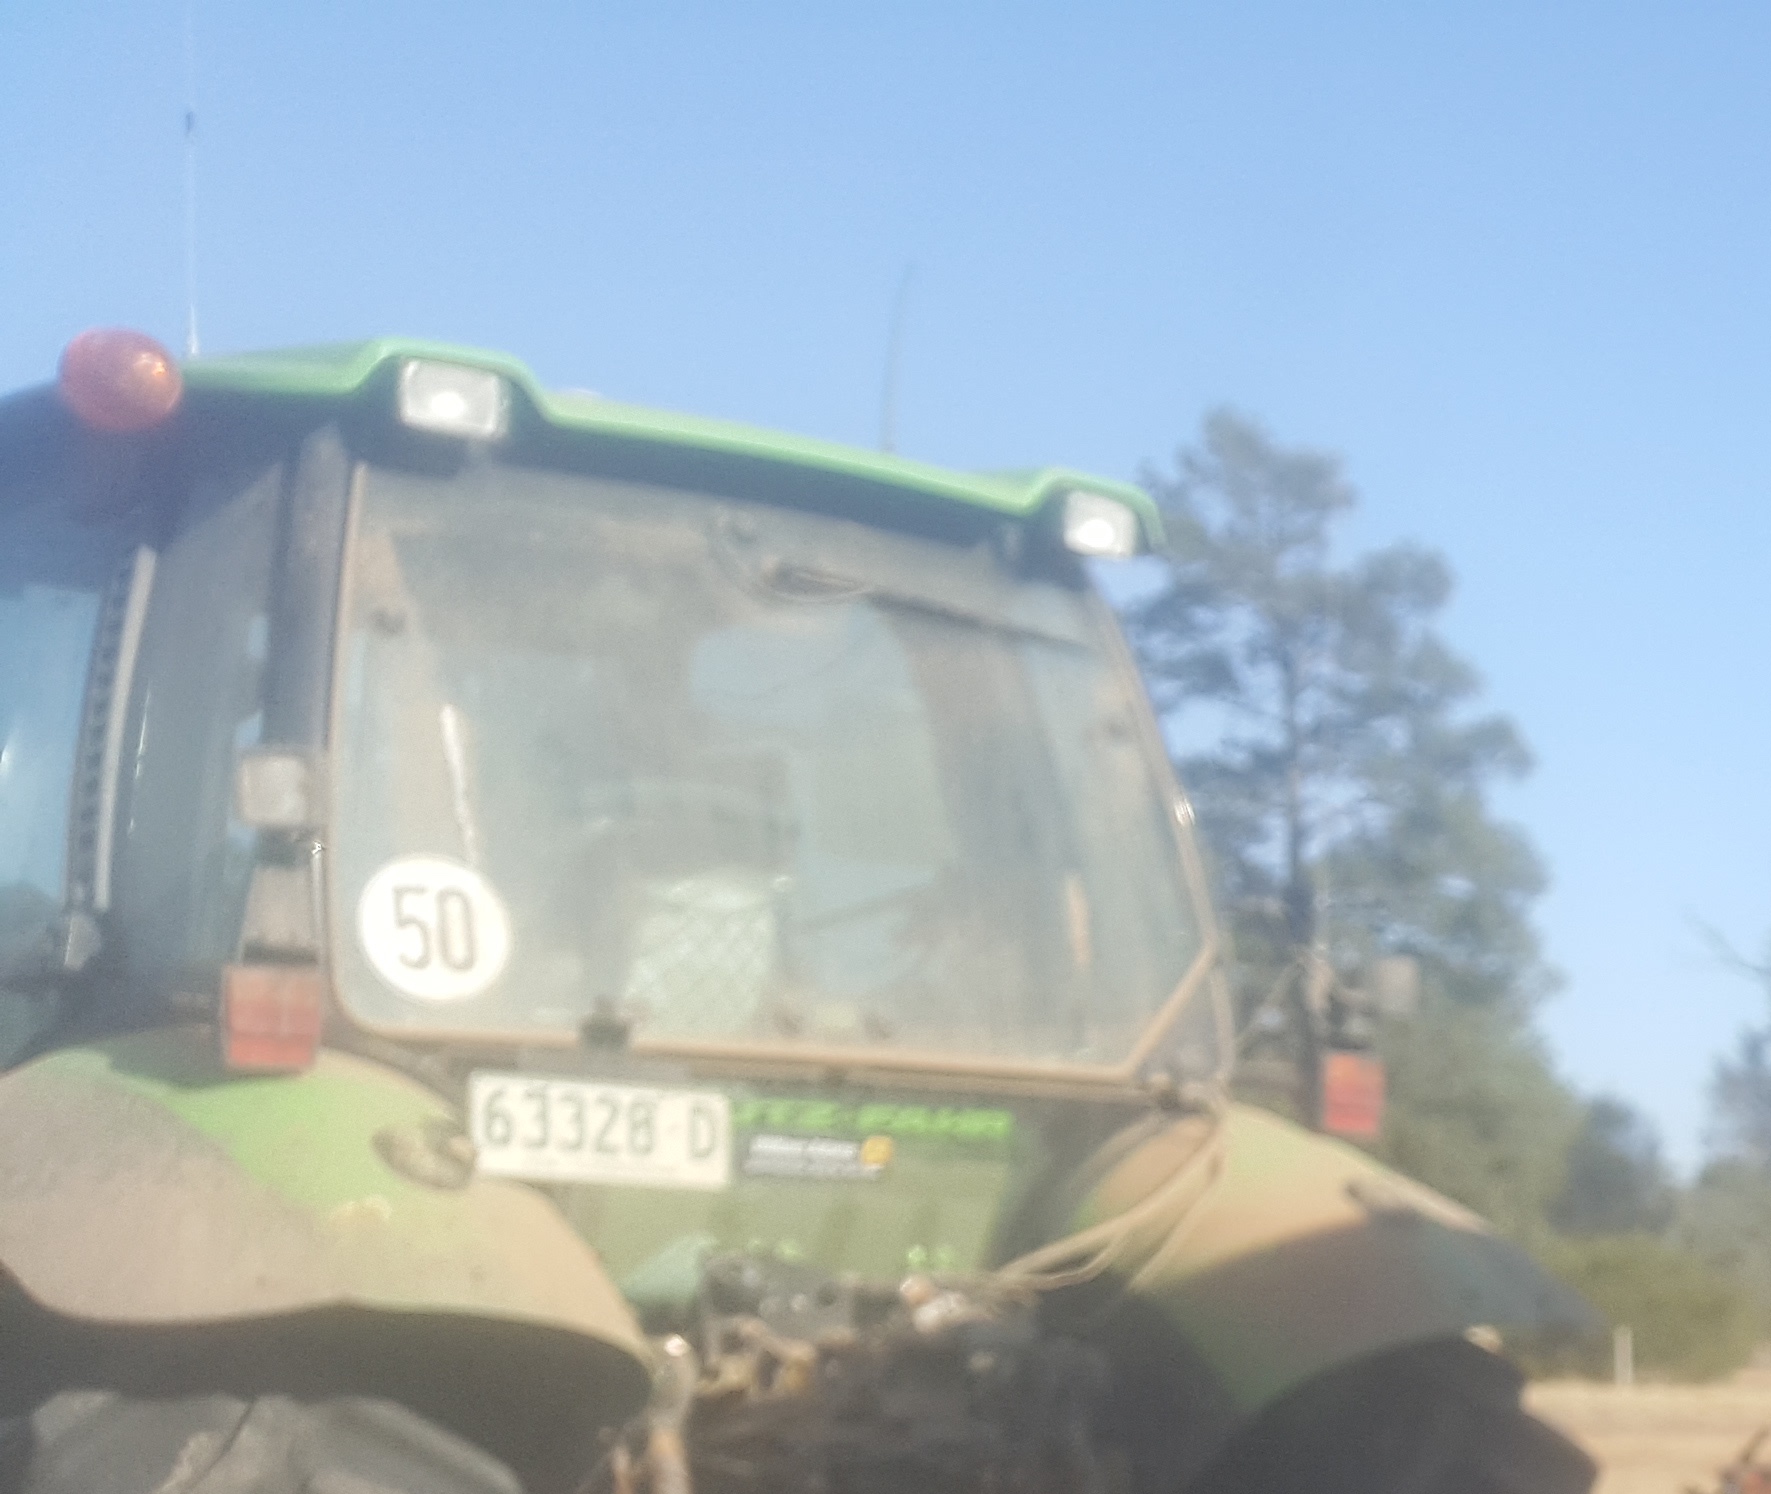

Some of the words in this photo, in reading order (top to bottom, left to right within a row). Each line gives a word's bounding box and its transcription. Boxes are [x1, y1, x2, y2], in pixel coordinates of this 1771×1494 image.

[392, 884, 477, 972] 50
[483, 1085, 656, 1156] 63328
[688, 1100, 719, 1160] D
